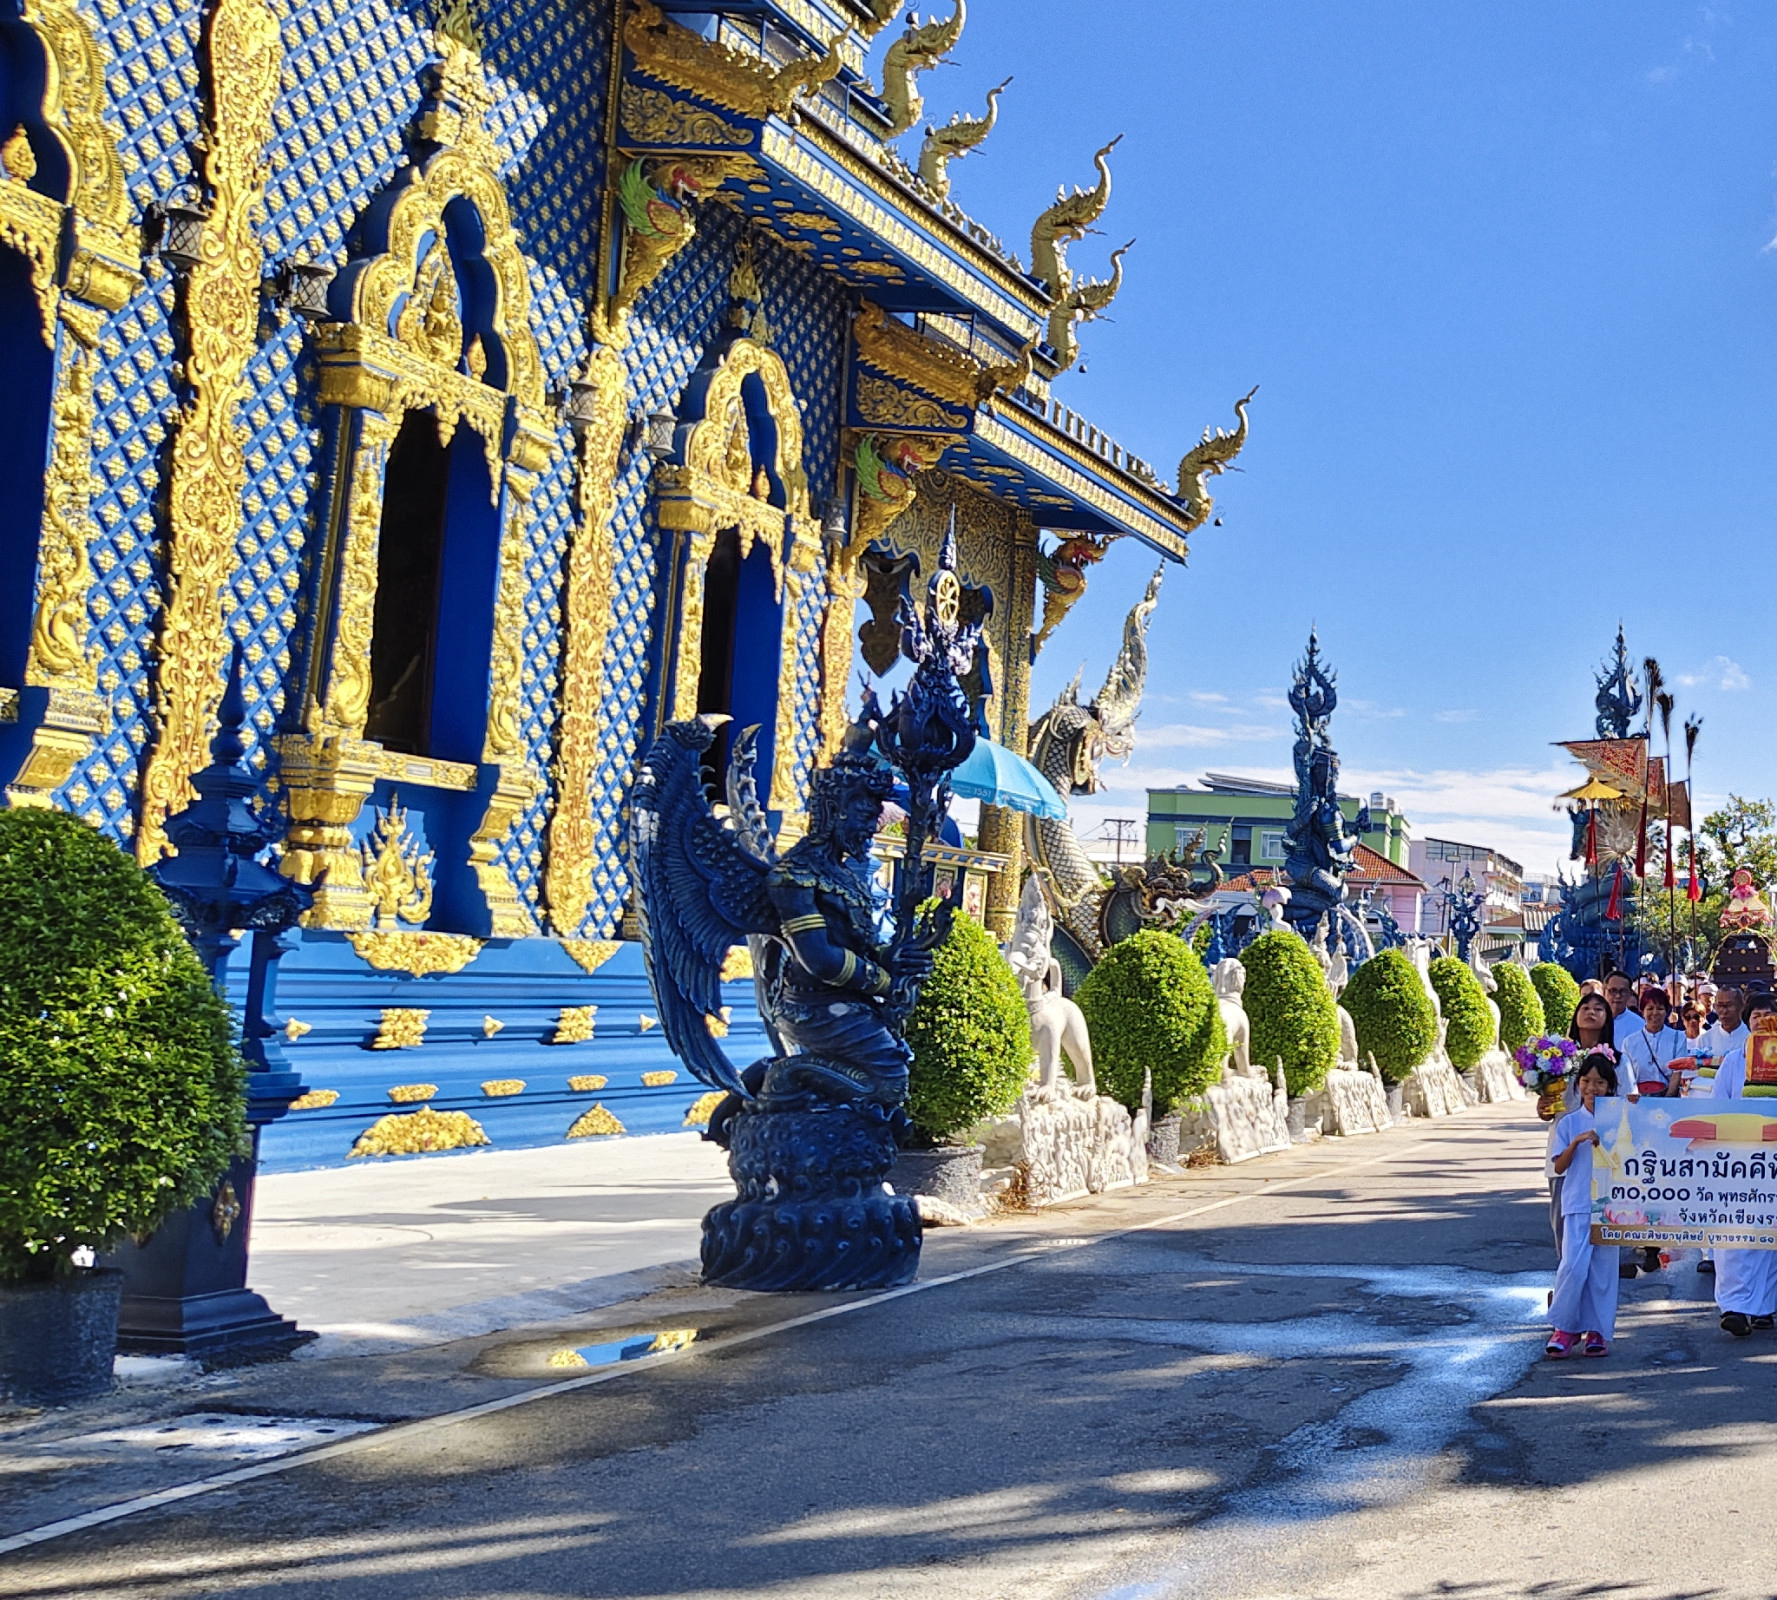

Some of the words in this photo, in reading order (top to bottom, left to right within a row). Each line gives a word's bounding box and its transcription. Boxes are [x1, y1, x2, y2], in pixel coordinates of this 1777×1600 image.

[1611, 1186, 1691, 1203] ๓๐,๐๐๐
[1696, 1186, 1714, 1202] วัด
[1601, 1228, 1621, 1240] โดย
